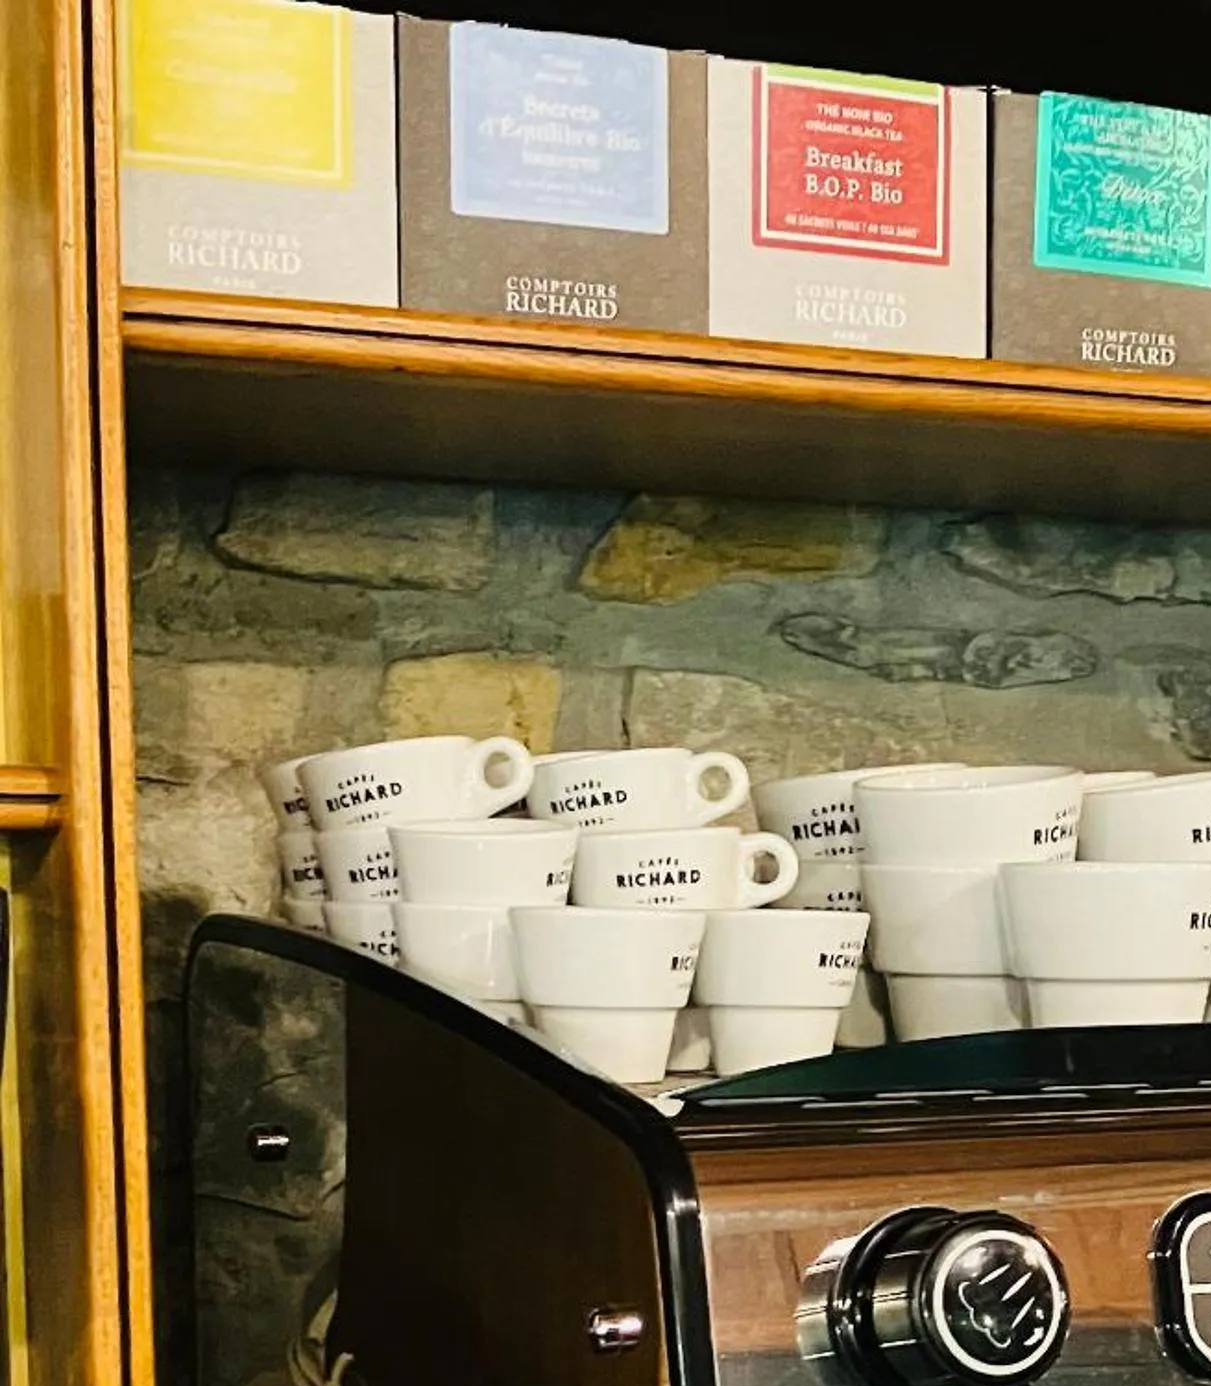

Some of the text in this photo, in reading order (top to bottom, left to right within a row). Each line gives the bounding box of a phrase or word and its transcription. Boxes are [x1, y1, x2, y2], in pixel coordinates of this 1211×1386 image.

[805, 146, 904, 178] Breakfast
[805, 173, 904, 205] B.O.P. Bio
[167, 223, 303, 250] COMPTOIRS
[167, 242, 302, 275] RICHARD
[505, 275, 619, 299] COMPTOIRS
[795, 283, 907, 306] COMPTOIRS
[505, 291, 619, 320] RICHARD
[794, 299, 907, 328] RICHARD
[1080, 326, 1178, 348] COMPTOIRS
[1080, 341, 1177, 366] RICHARD
[325, 781, 403, 813] RICHARD
[550, 789, 628, 815] RICHARD
[616, 868, 702, 889] RICHARD
